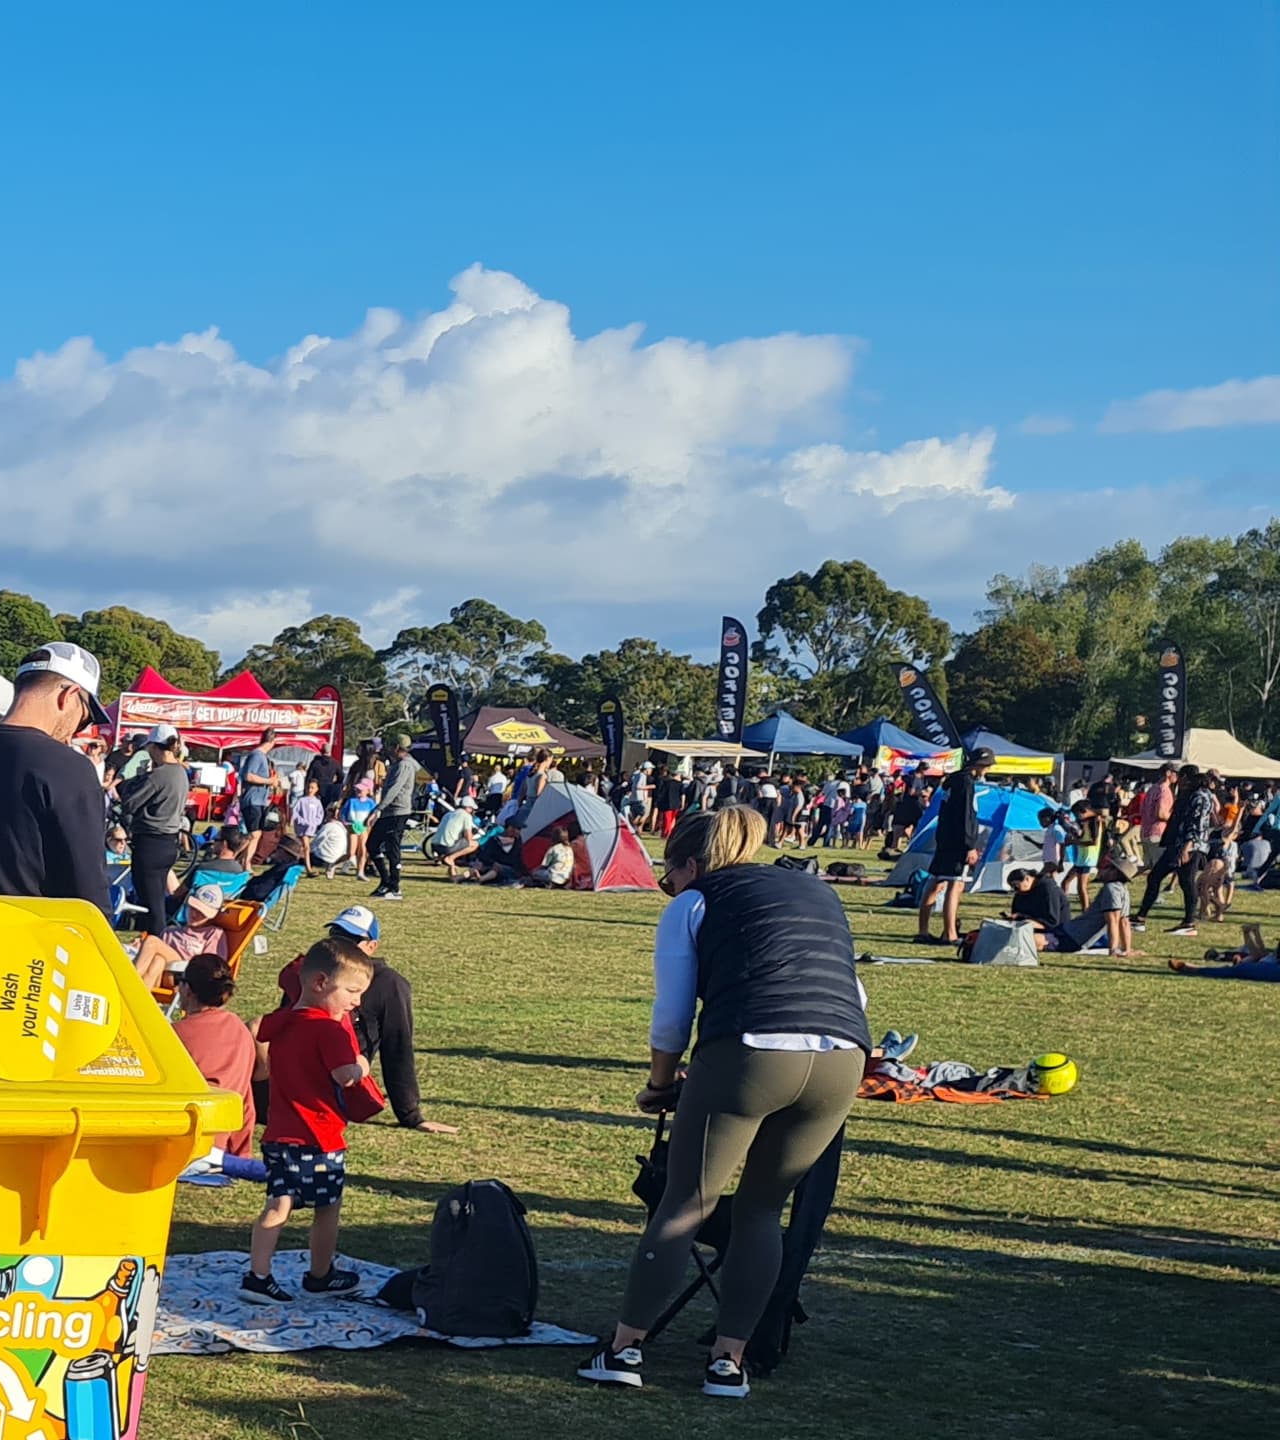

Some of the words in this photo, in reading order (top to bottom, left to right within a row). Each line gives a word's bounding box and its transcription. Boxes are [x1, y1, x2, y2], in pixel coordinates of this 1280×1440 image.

[196, 706, 215, 721] GET
[23, 958, 45, 1002] hands
[22, 1003, 40, 1038] your
